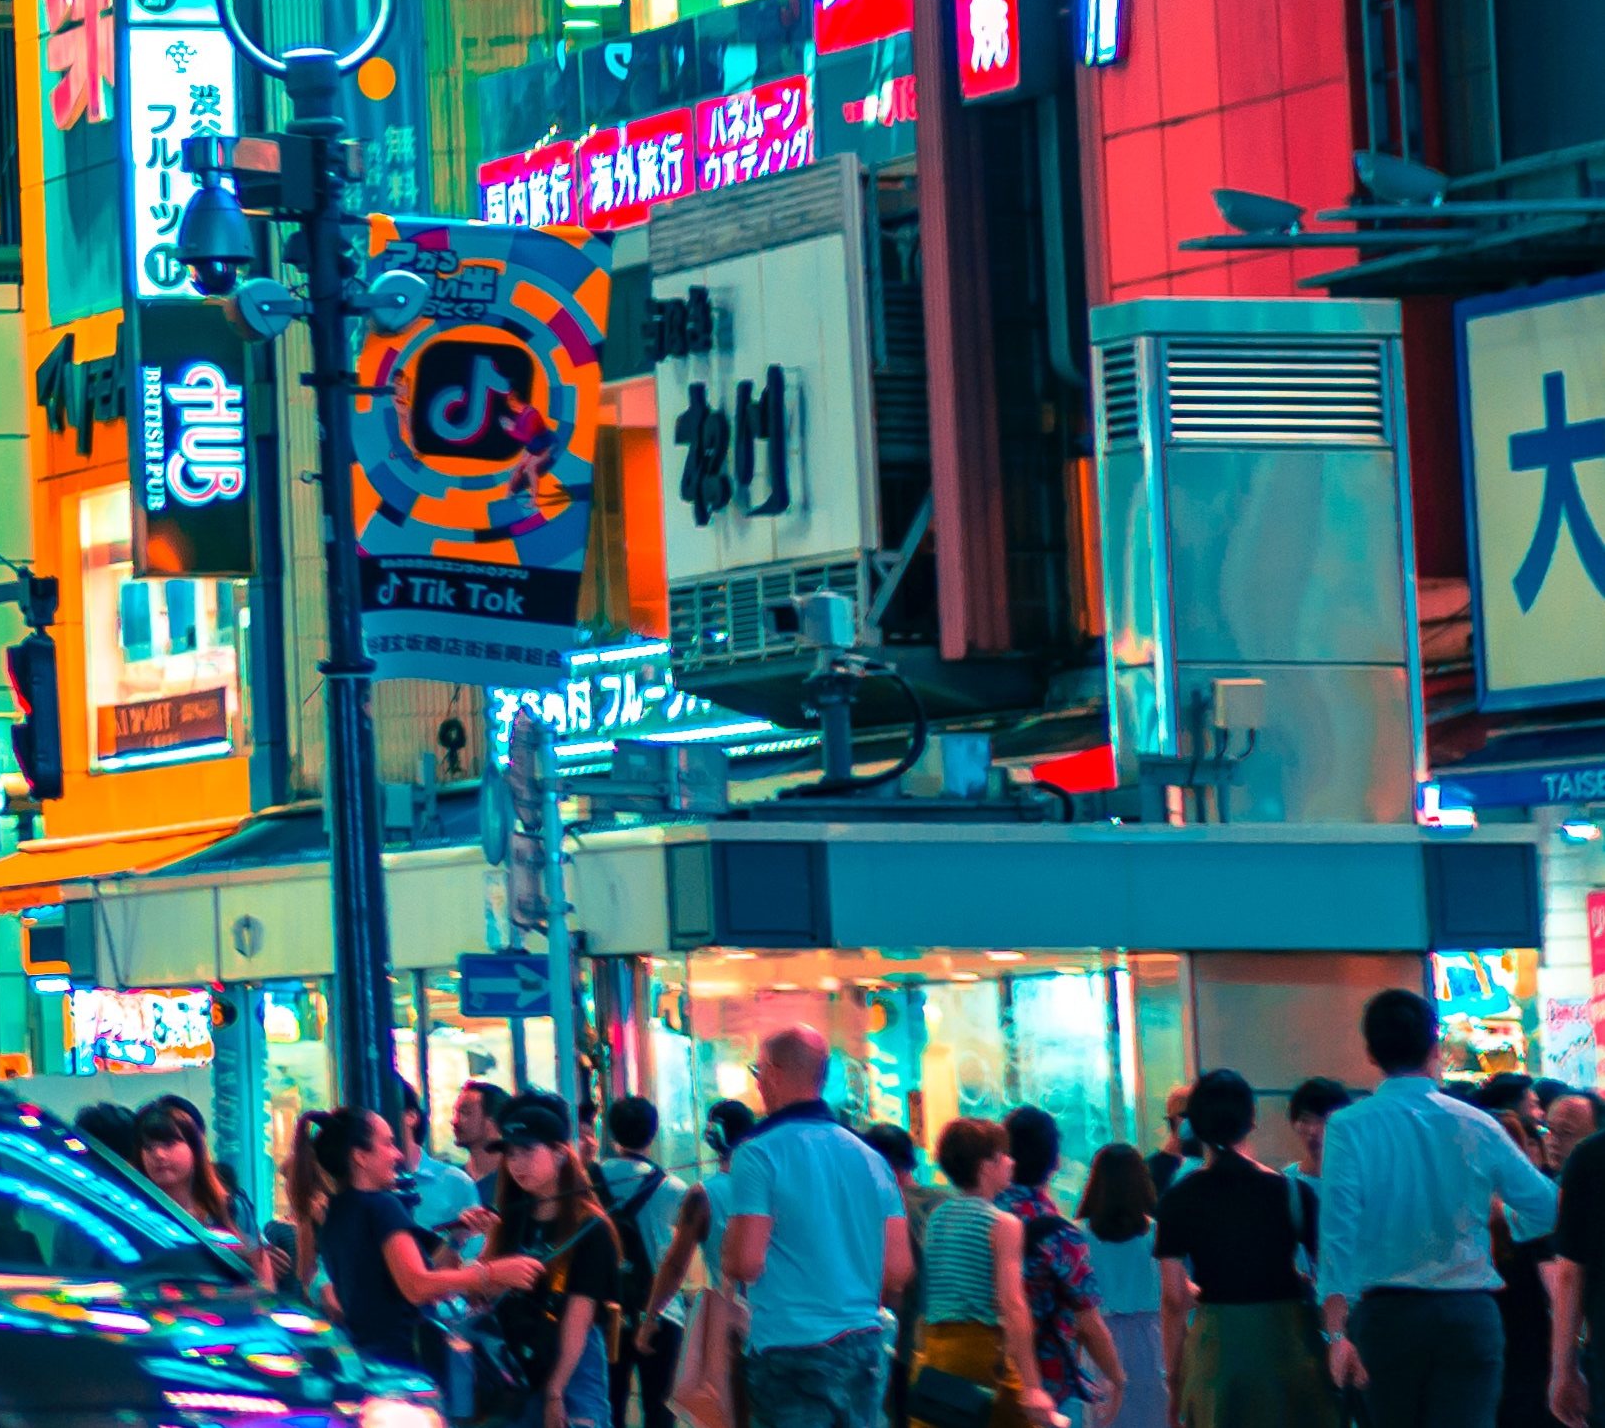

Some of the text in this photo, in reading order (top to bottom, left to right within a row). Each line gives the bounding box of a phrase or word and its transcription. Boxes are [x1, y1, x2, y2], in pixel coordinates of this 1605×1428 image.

[145, 102, 185, 234] フルーツ
[486, 133, 686, 228] 国内旅行 海外旅行
[143, 365, 166, 513] BRITISH PUB
[164, 364, 248, 506] HUB
[408, 578, 524, 616] Tik Tok
